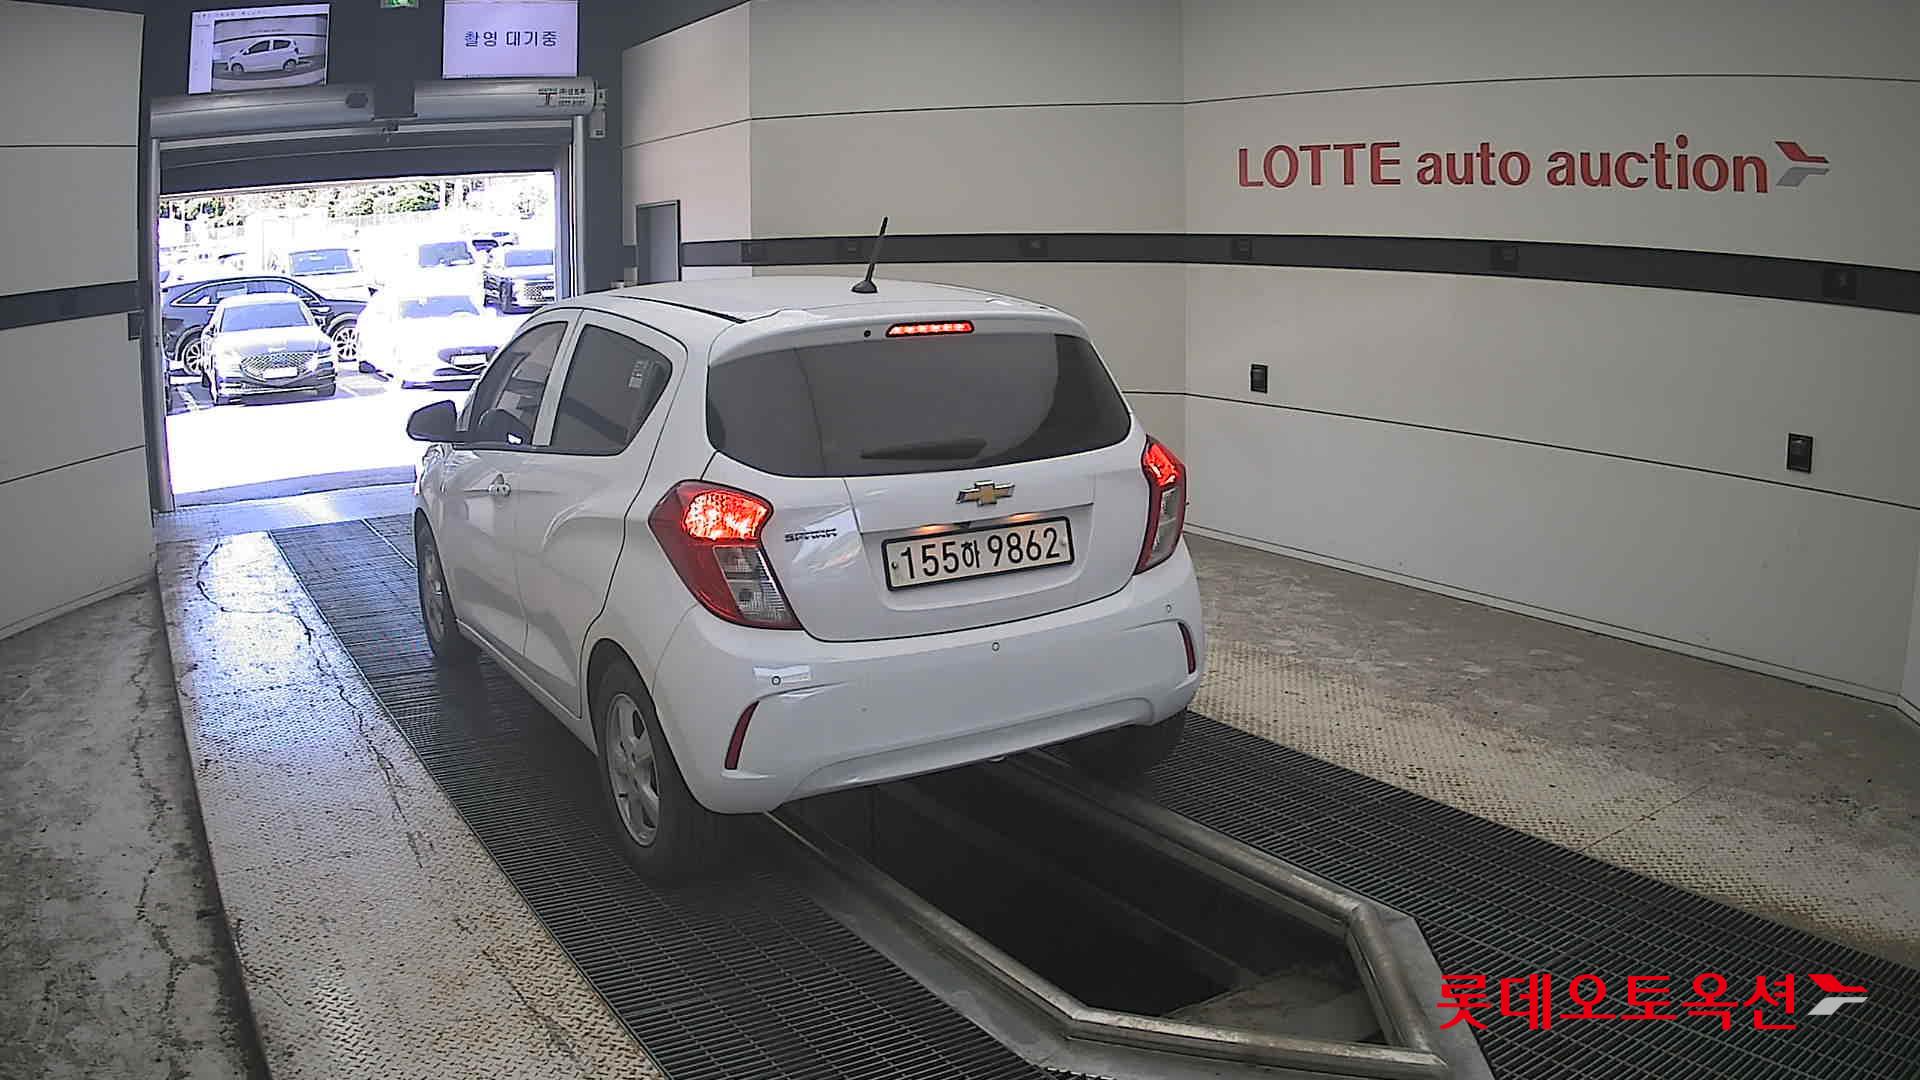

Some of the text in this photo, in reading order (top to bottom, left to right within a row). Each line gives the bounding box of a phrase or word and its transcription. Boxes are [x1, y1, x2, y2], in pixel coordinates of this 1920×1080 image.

[464, 31, 558, 47] 촬영 대기중
[1238, 134, 1769, 193] LOTTE auto auction
[900, 527, 1061, 580] 155하 9862
